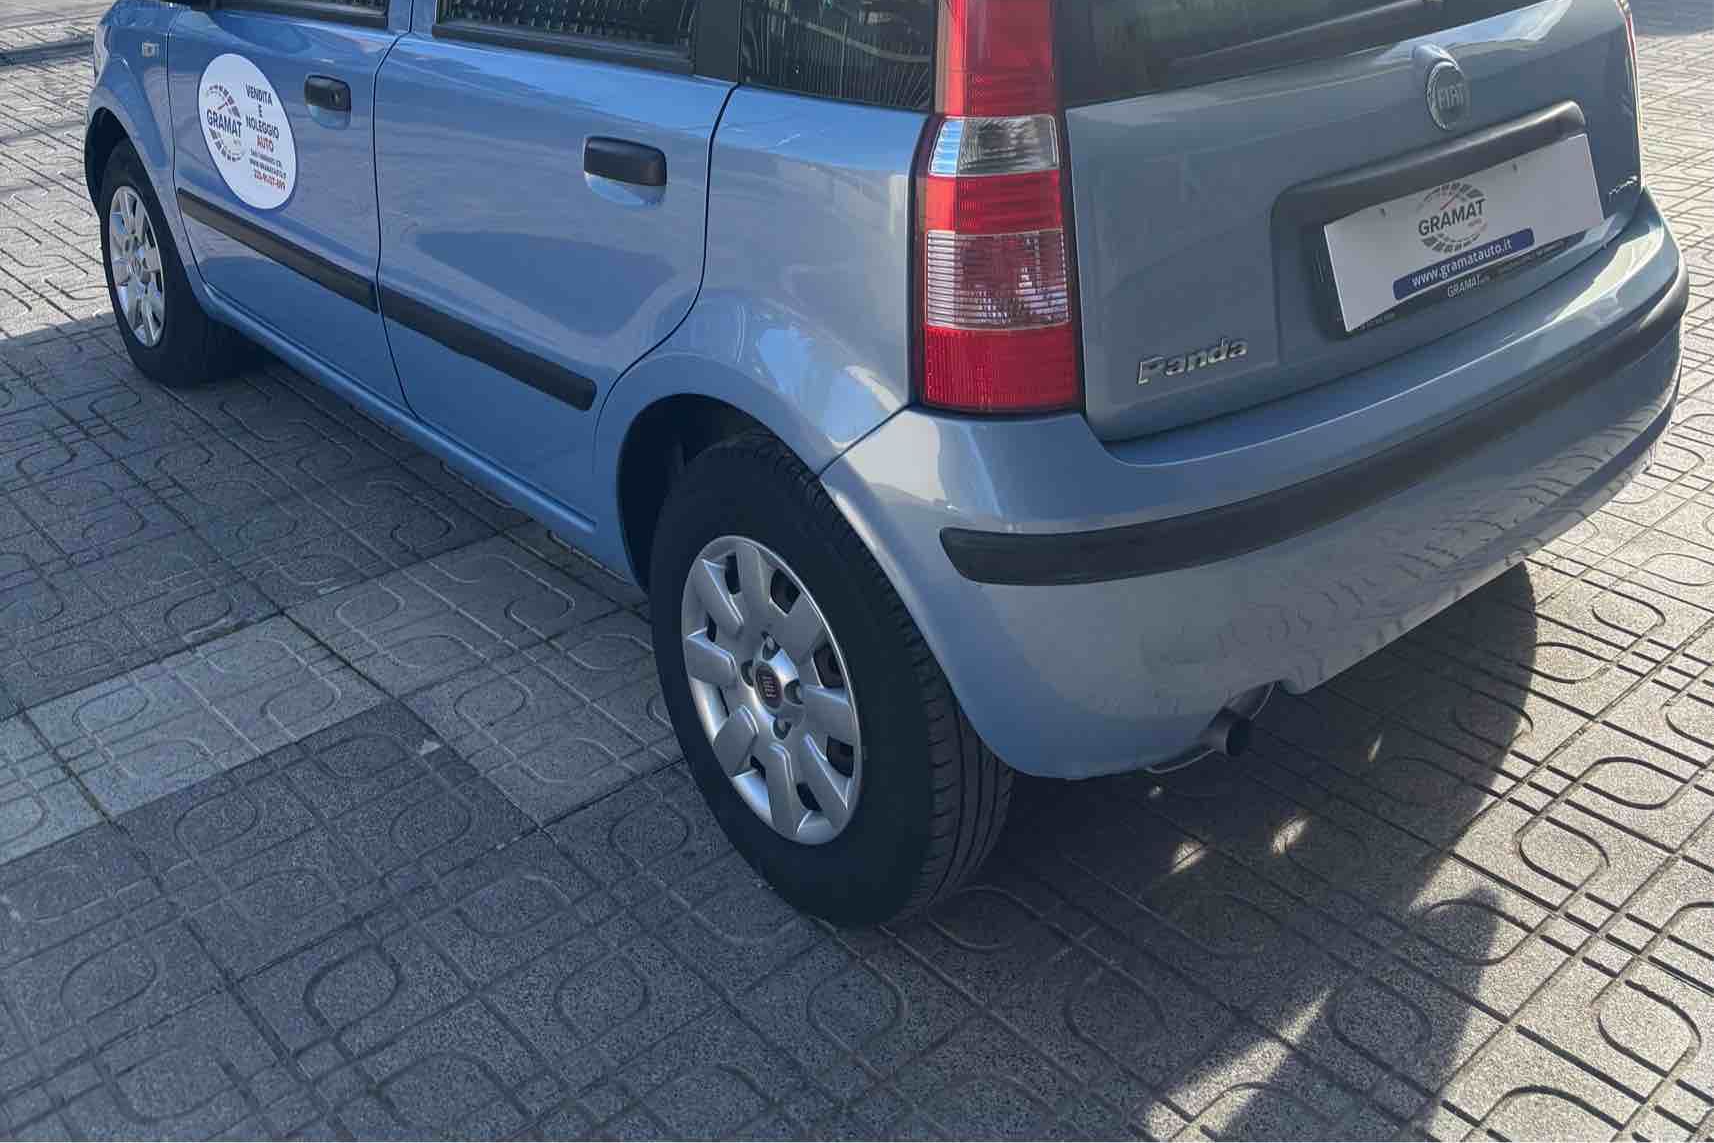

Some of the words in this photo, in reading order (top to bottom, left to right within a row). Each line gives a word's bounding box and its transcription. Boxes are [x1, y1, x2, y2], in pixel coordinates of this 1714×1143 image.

[245, 84, 273, 106] VENDITA
[207, 109, 242, 139] GRAMAT
[245, 115, 280, 139] NOLEGGIO
[256, 136, 274, 154] AUTO
[1418, 198, 1487, 236] GRAMAT
[1411, 238, 1513, 288] www.gramatauto.it
[1447, 274, 1481, 299] GRAMAT
[1138, 338, 1248, 385] Panda
